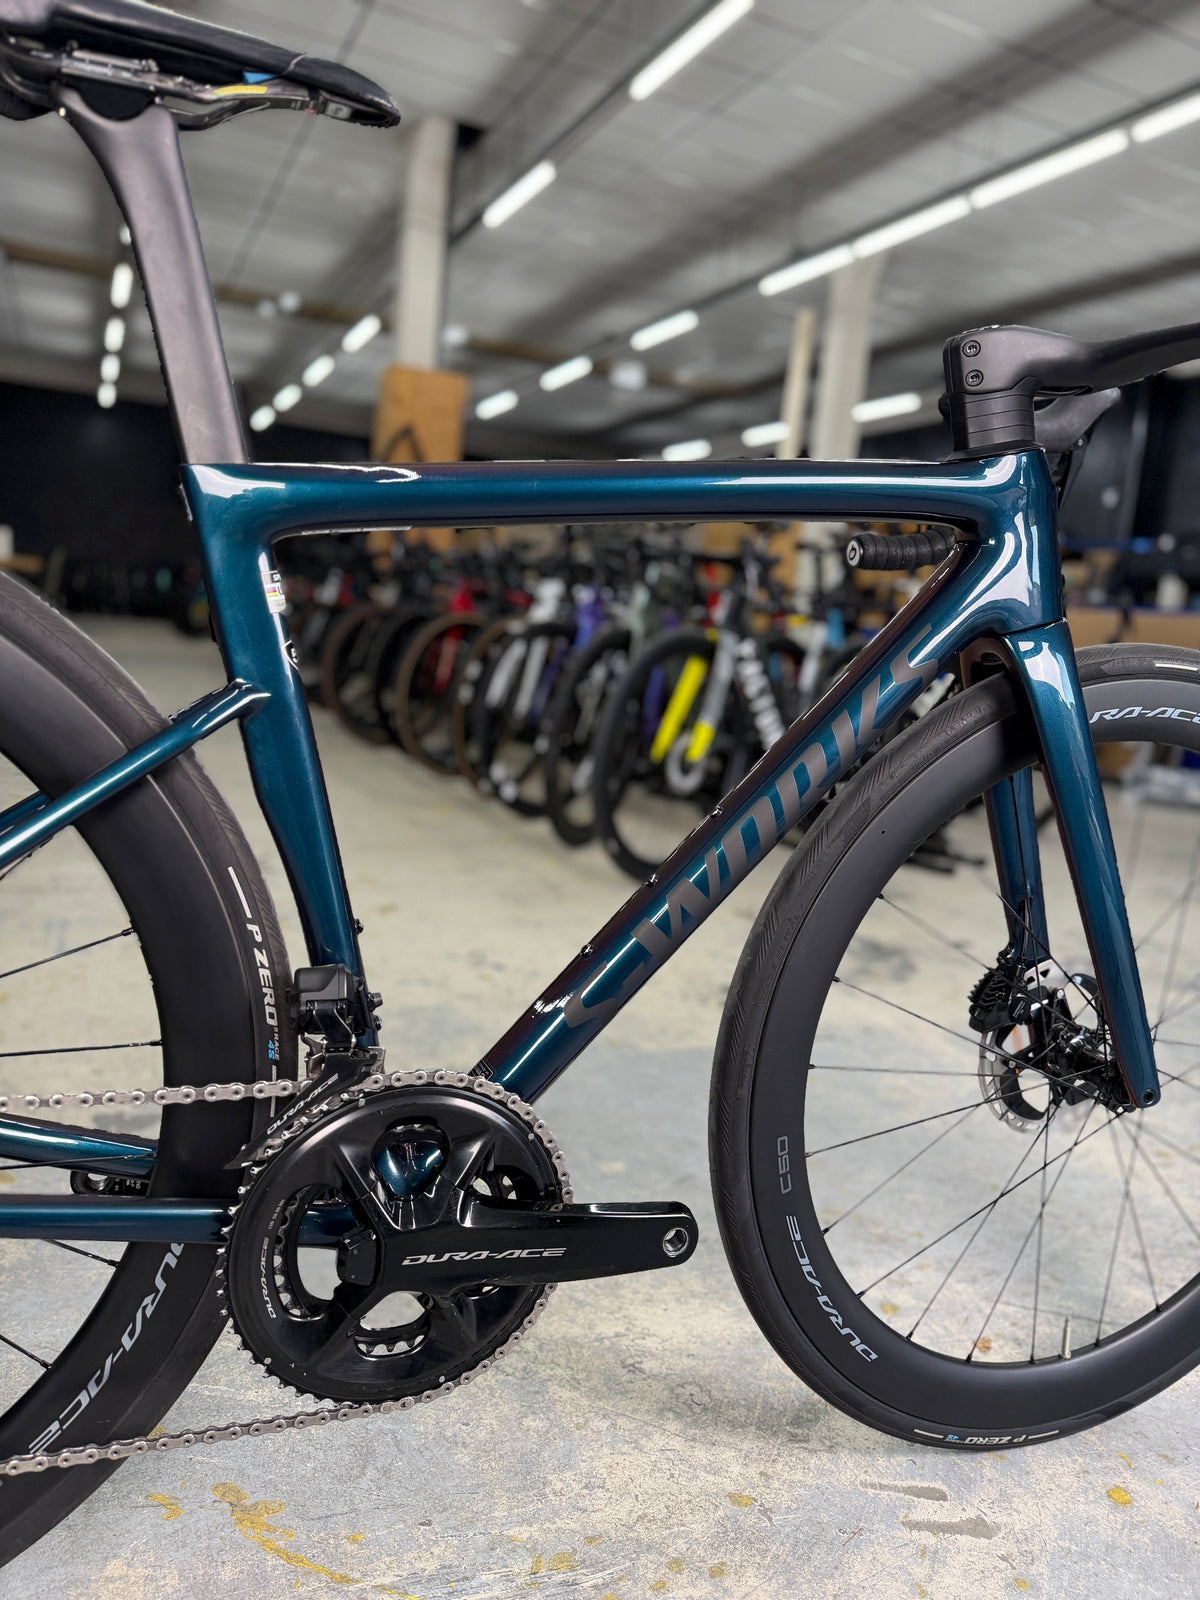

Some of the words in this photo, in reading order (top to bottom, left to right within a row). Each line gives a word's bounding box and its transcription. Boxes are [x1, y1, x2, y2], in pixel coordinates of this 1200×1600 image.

[1088, 706, 1200, 724] RA-AC
[563, 622, 938, 1028] S-WORKS
[246, 923, 262, 942] P
[253, 947, 278, 1026] ZERO
[268, 1039, 275, 1060] 4S
[266, 1073, 339, 1135] DURA-ACE
[777, 1135, 792, 1194] C50
[401, 1247, 567, 1266] DURA-ACE
[260, 1236, 277, 1319] DURA-ACE
[786, 1215, 879, 1362] DURA-ACE
[963, 1436, 1012, 1445] ZERO
[1012, 1434, 1027, 1443] P
